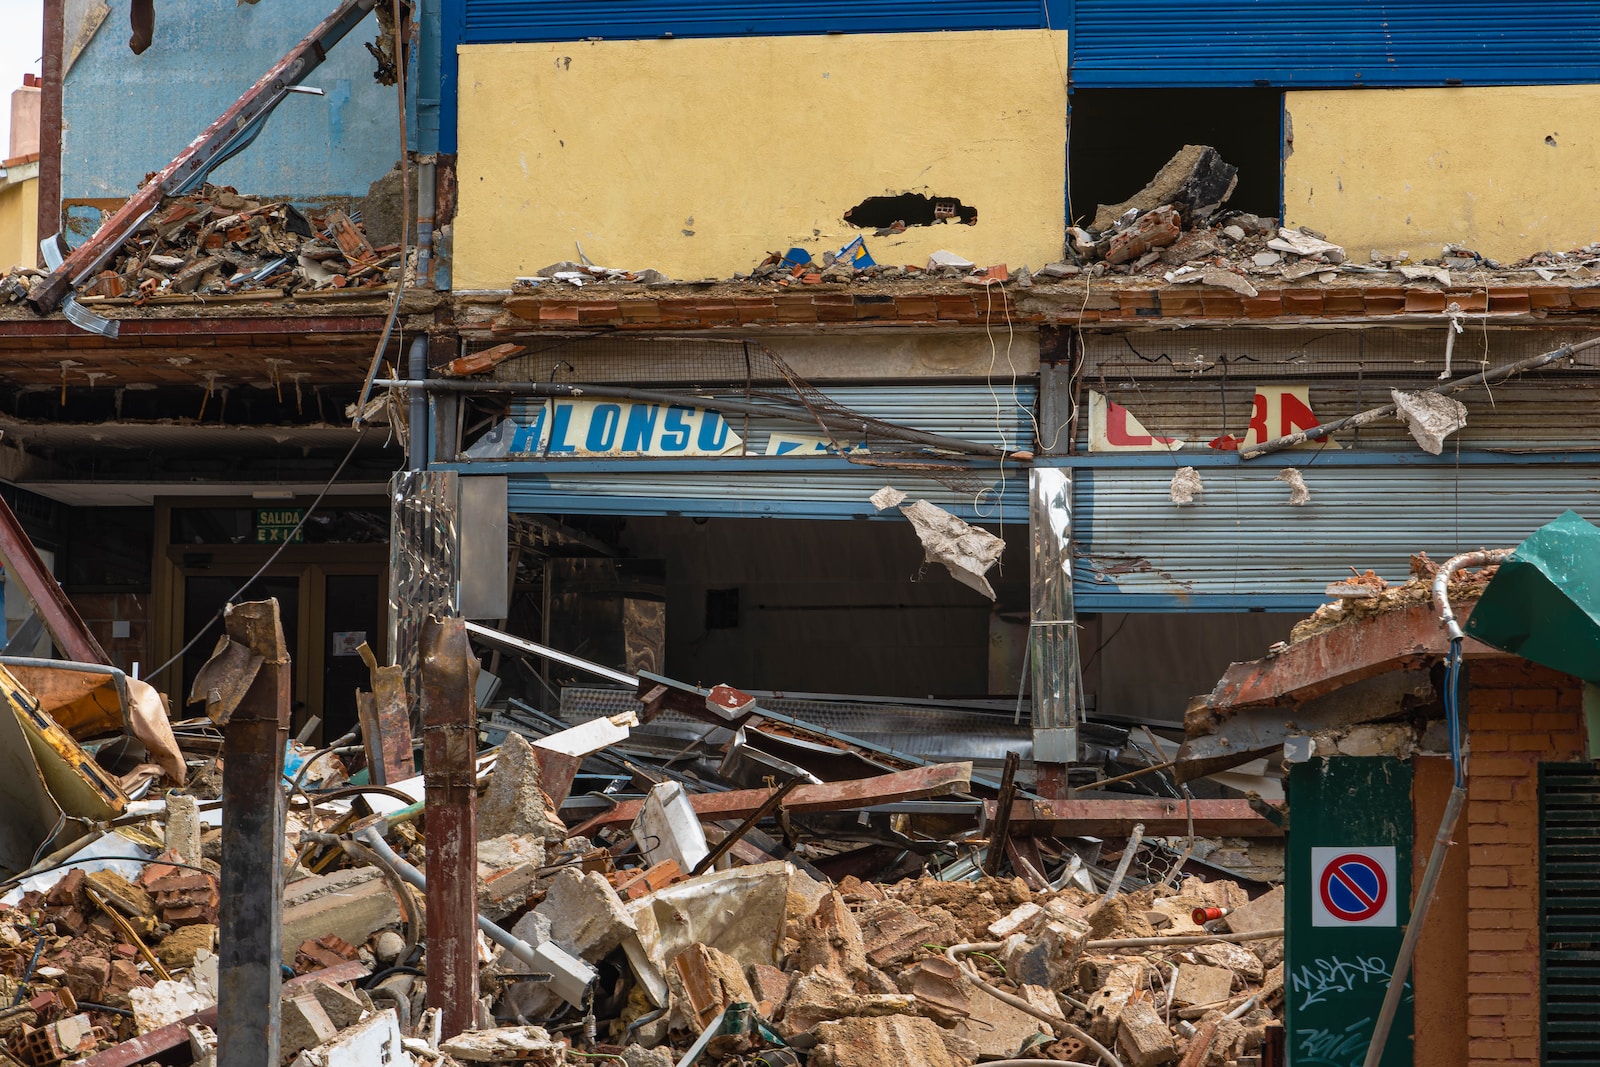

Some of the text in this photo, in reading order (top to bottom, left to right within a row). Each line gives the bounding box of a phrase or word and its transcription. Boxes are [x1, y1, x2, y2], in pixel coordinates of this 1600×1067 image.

[509, 403, 729, 452] ALONSO
[260, 511, 300, 524] SALIDA
[258, 529, 302, 541] EXIT
